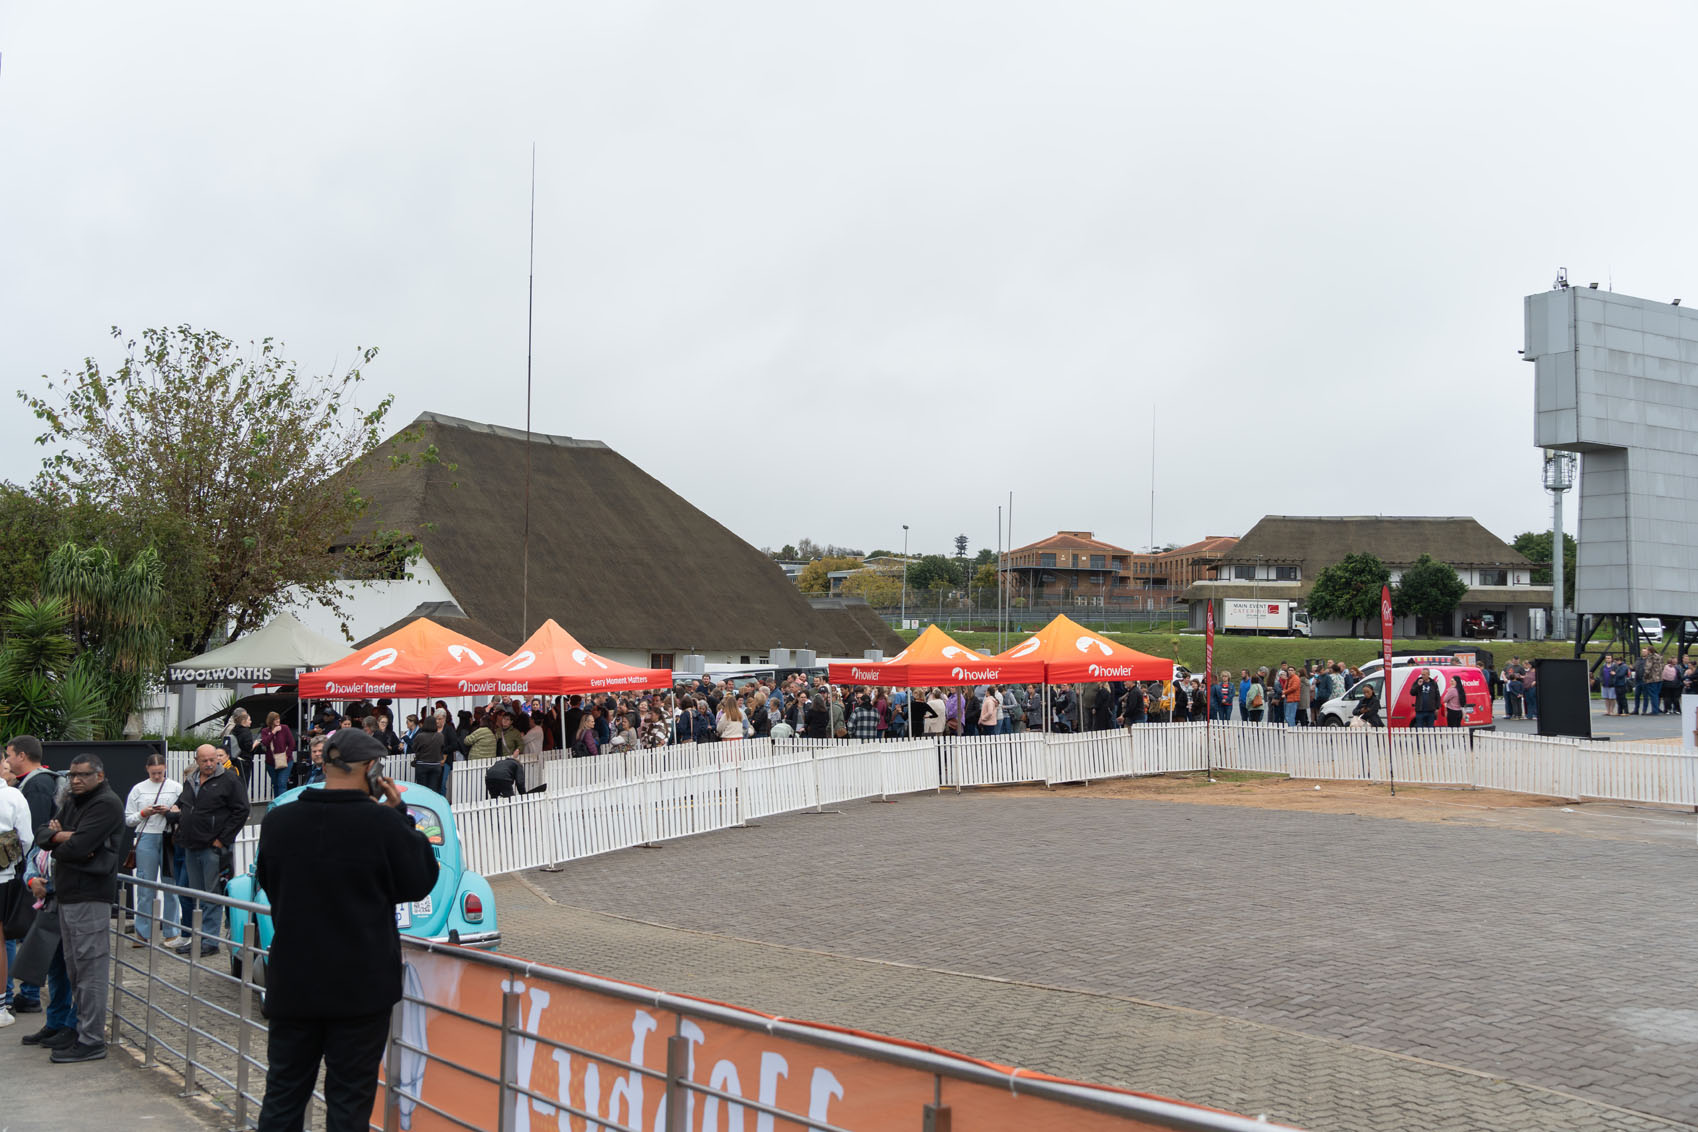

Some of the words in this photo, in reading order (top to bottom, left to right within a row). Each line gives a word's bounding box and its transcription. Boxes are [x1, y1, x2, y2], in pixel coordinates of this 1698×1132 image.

[170, 667, 272, 681] WOOLWORTHS
[858, 668, 880, 680] howler
[964, 669, 999, 680] howler
[1100, 665, 1132, 677] howler
[467, 681, 497, 693] howler
[497, 680, 528, 692] loaded
[590, 678, 606, 688] Every
[606, 677, 628, 686] Moment
[628, 675, 648, 684] Matters
[335, 682, 364, 694] howler
[365, 682, 397, 693] loaded
